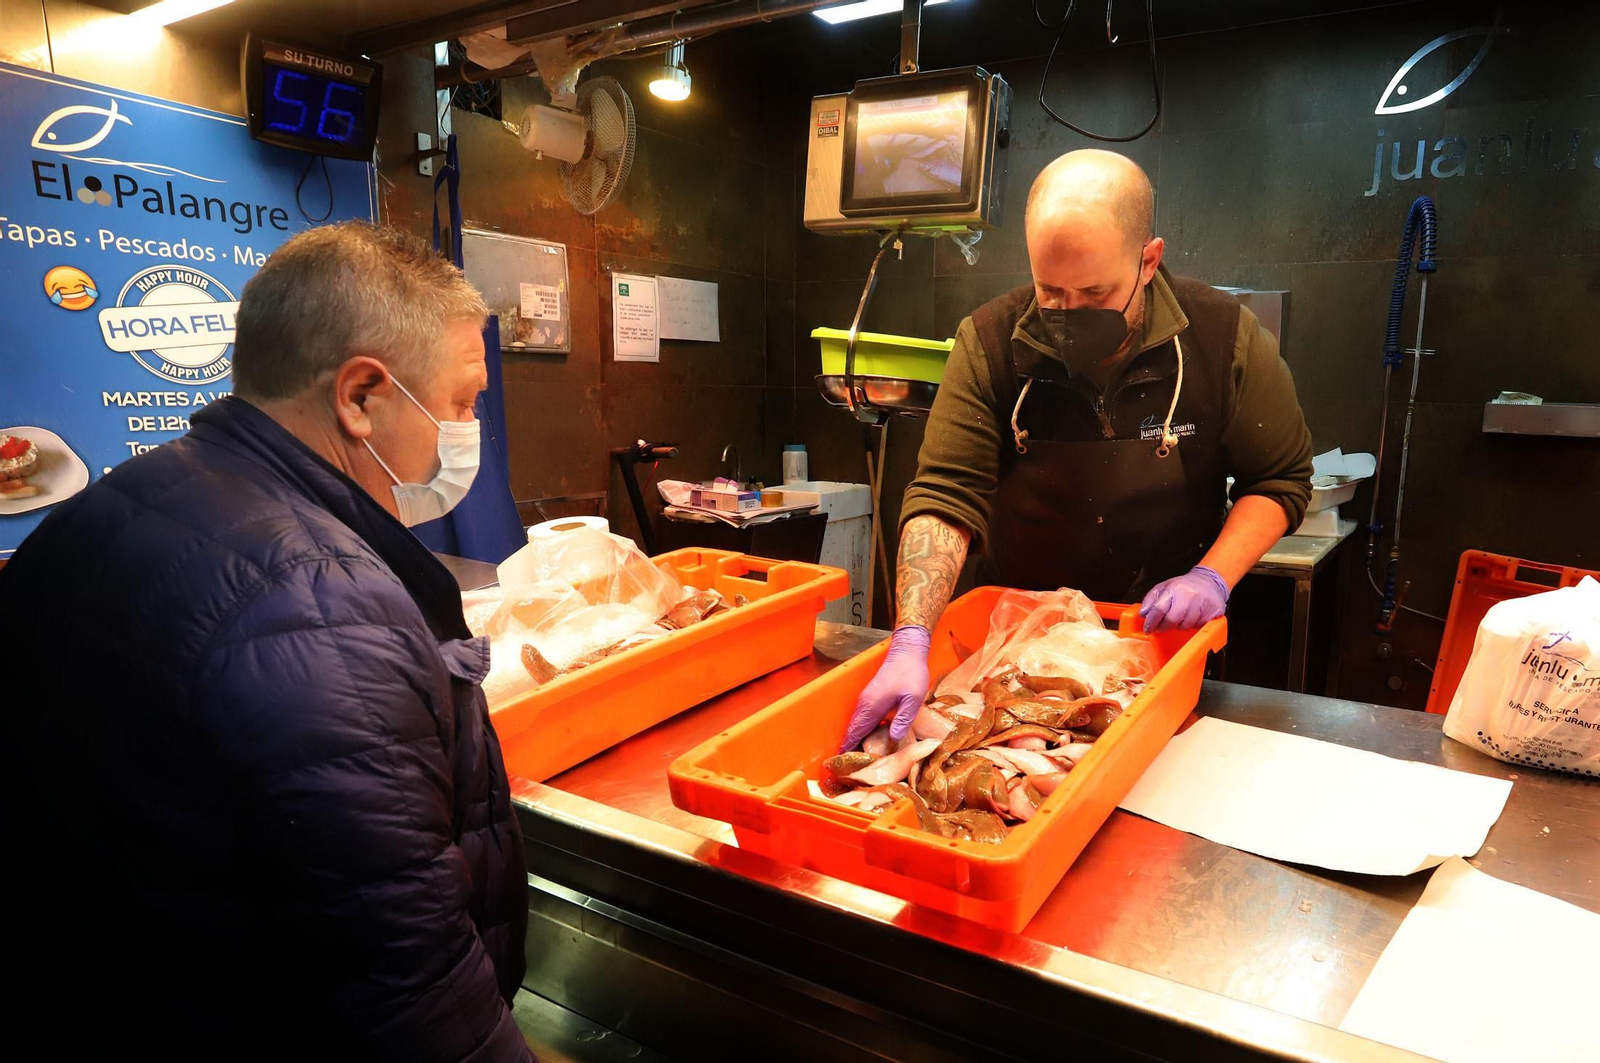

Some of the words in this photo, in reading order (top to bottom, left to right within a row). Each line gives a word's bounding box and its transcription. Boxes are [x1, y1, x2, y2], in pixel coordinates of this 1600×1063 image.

[284, 49, 303, 64] SU
[306, 54, 354, 76] TURNO
[269, 69, 355, 141] 56
[818, 126, 838, 135] DIBAL
[31, 160, 73, 202] El
[113, 173, 289, 234] Palangre
[98, 229, 216, 262] Pescados
[233, 245, 271, 267] Ma
[136, 270, 172, 292] HAPPY
[175, 270, 209, 290] HOUR
[106, 316, 189, 339] HORA
[160, 362, 200, 379] HAPPY
[201, 356, 231, 378] HOUR
[102, 391, 190, 407] MARTES
[192, 391, 209, 406] A
[127, 416, 156, 432] DE
